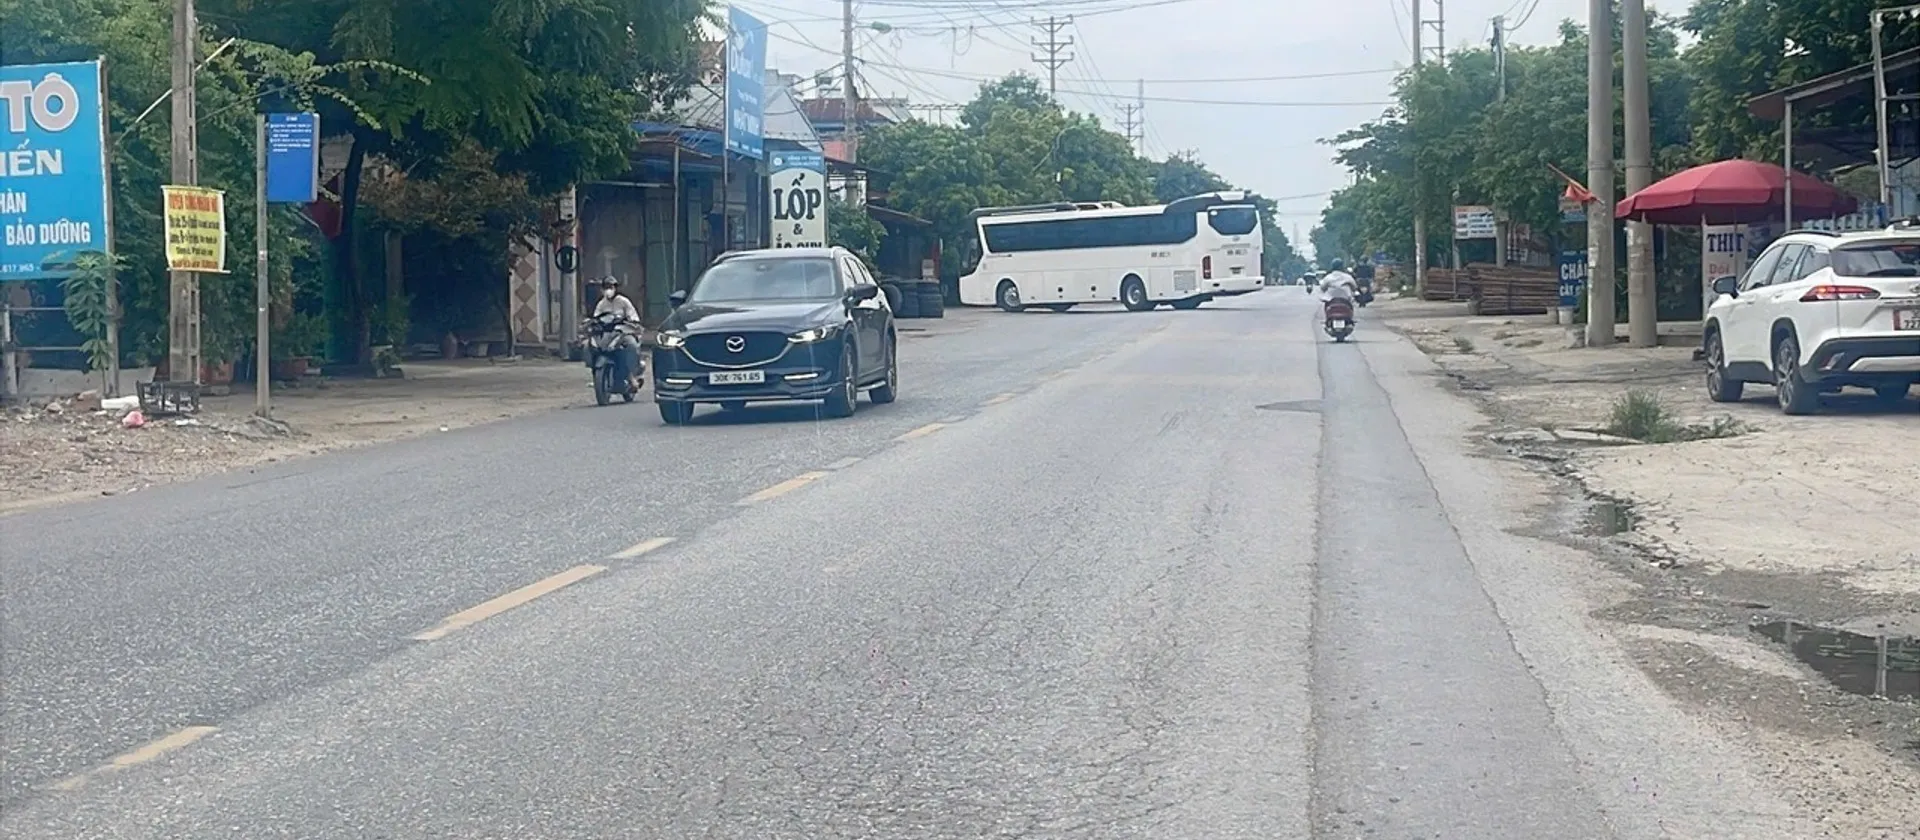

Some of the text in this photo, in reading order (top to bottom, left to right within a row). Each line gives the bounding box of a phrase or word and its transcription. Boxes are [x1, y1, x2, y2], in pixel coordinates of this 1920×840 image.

[0, 72, 79, 132] TÔ
[773, 173, 821, 220] LỐP
[5, 217, 91, 246] BẢO DƯỠNG
[793, 223, 803, 235] &
[1707, 233, 1744, 258] THỊT
